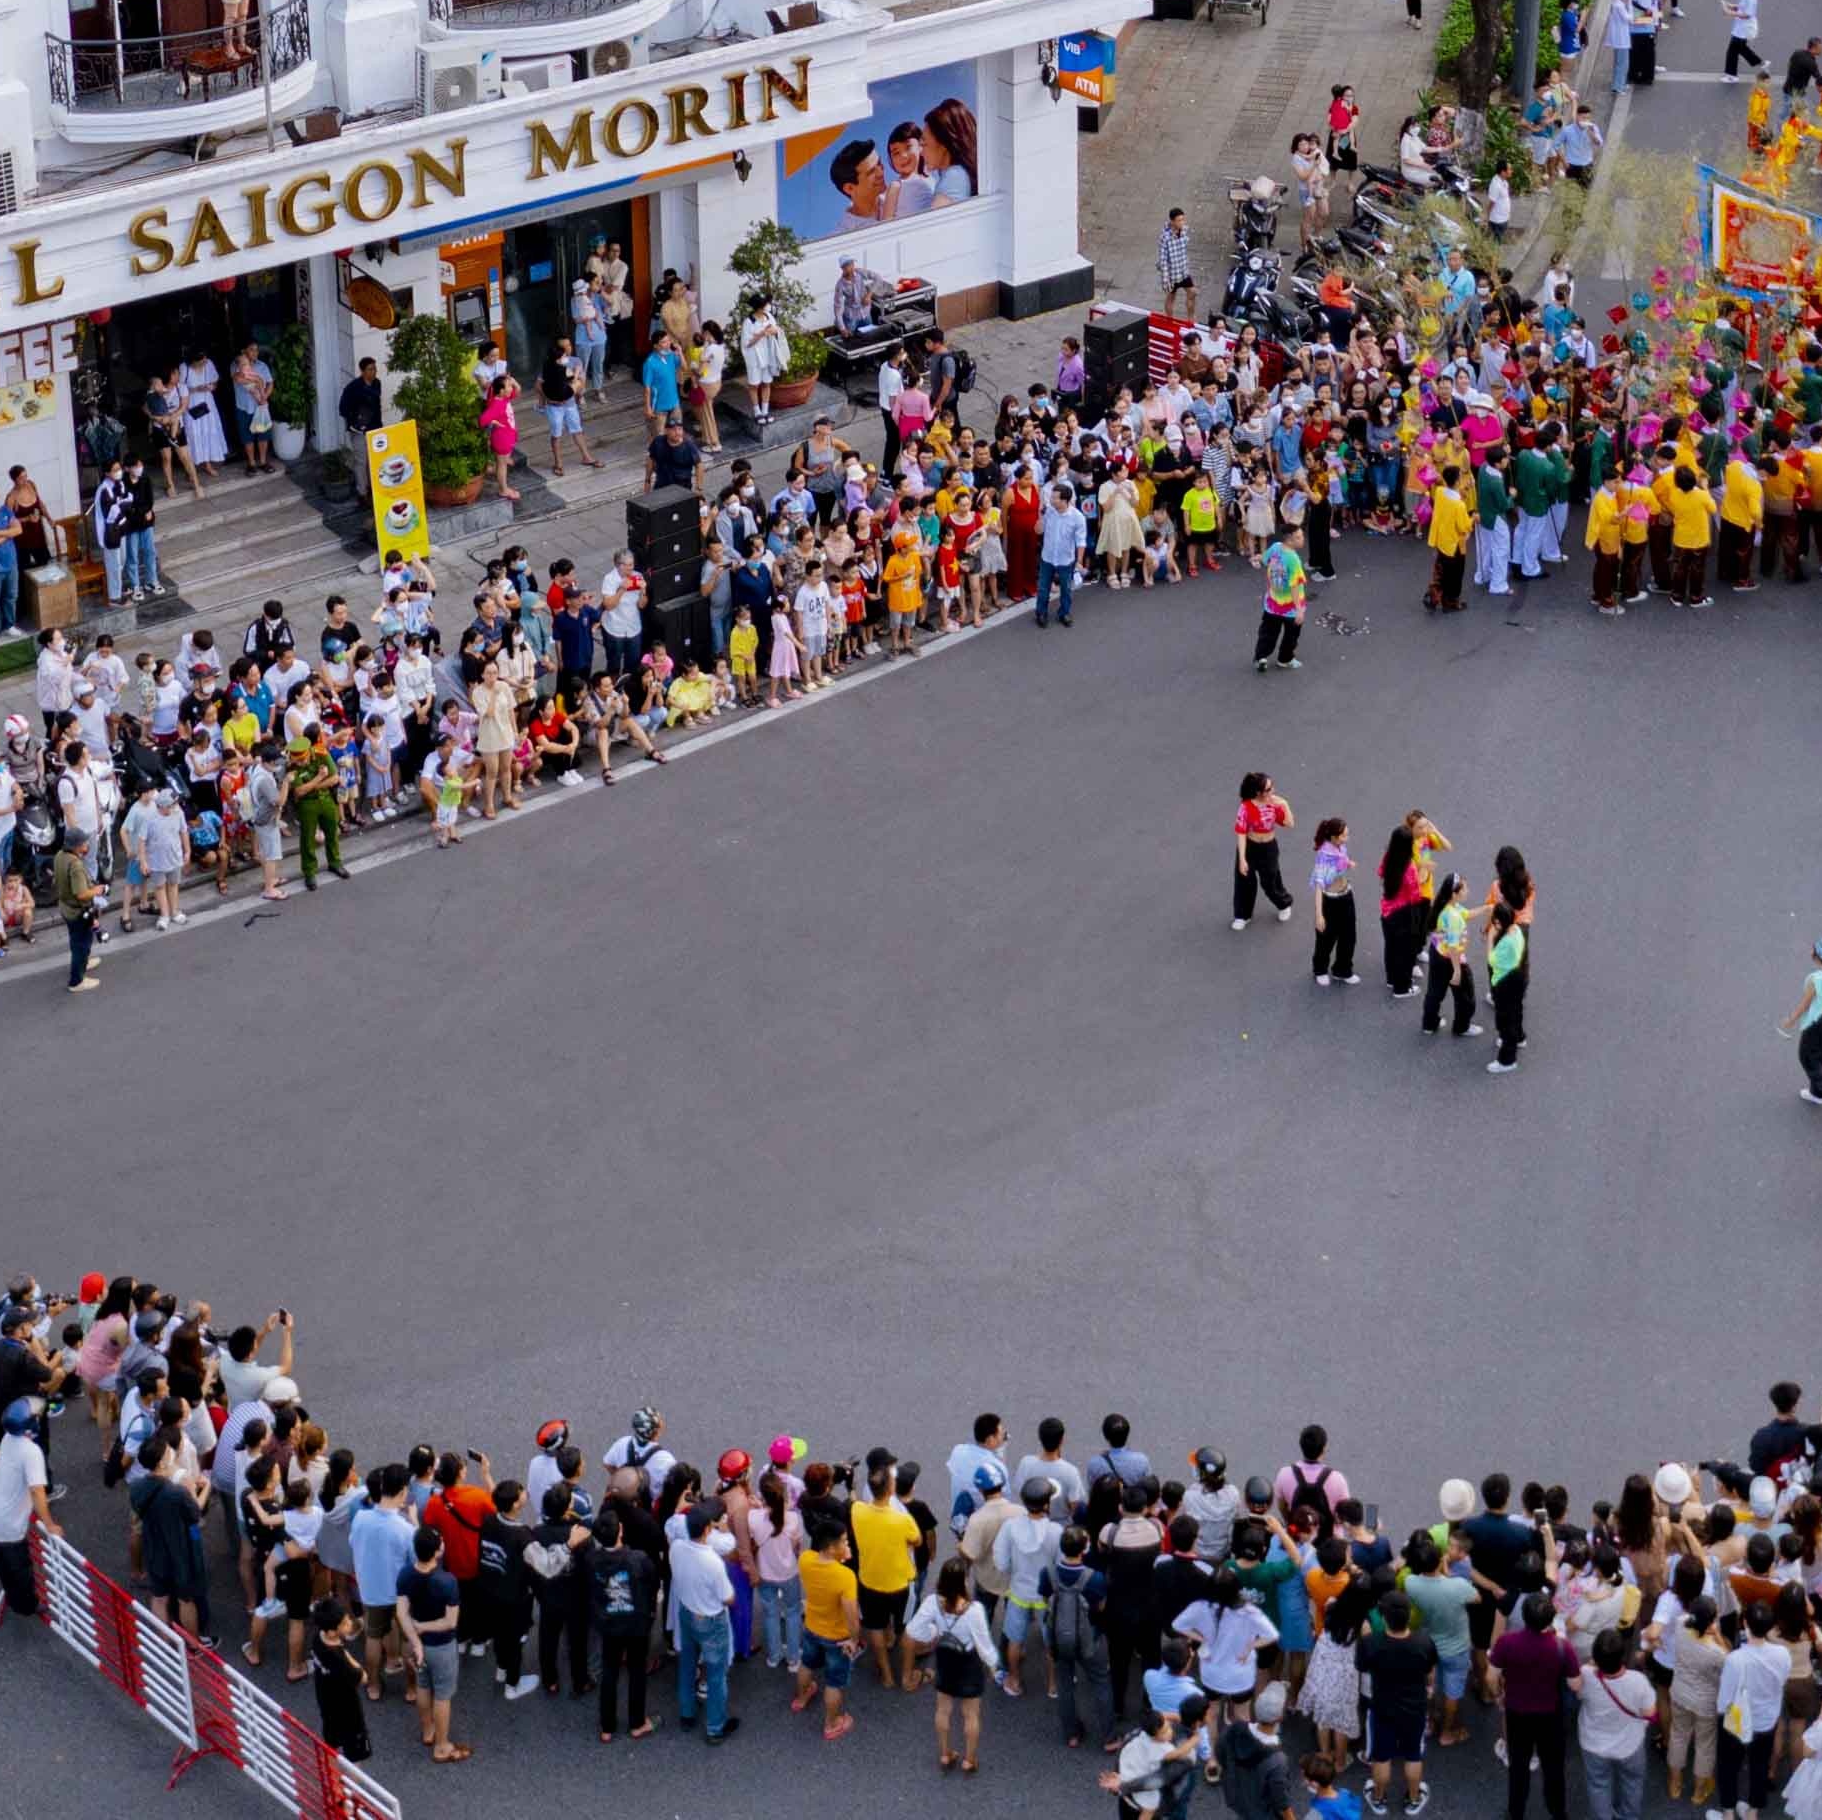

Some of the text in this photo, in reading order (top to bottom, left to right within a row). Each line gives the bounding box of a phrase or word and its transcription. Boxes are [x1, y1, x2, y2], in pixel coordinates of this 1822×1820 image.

[1063, 39, 1081, 56] VIB
[1074, 76, 1101, 98] ATM
[128, 136, 469, 277] SAIGON
[524, 56, 812, 181] MORIN
